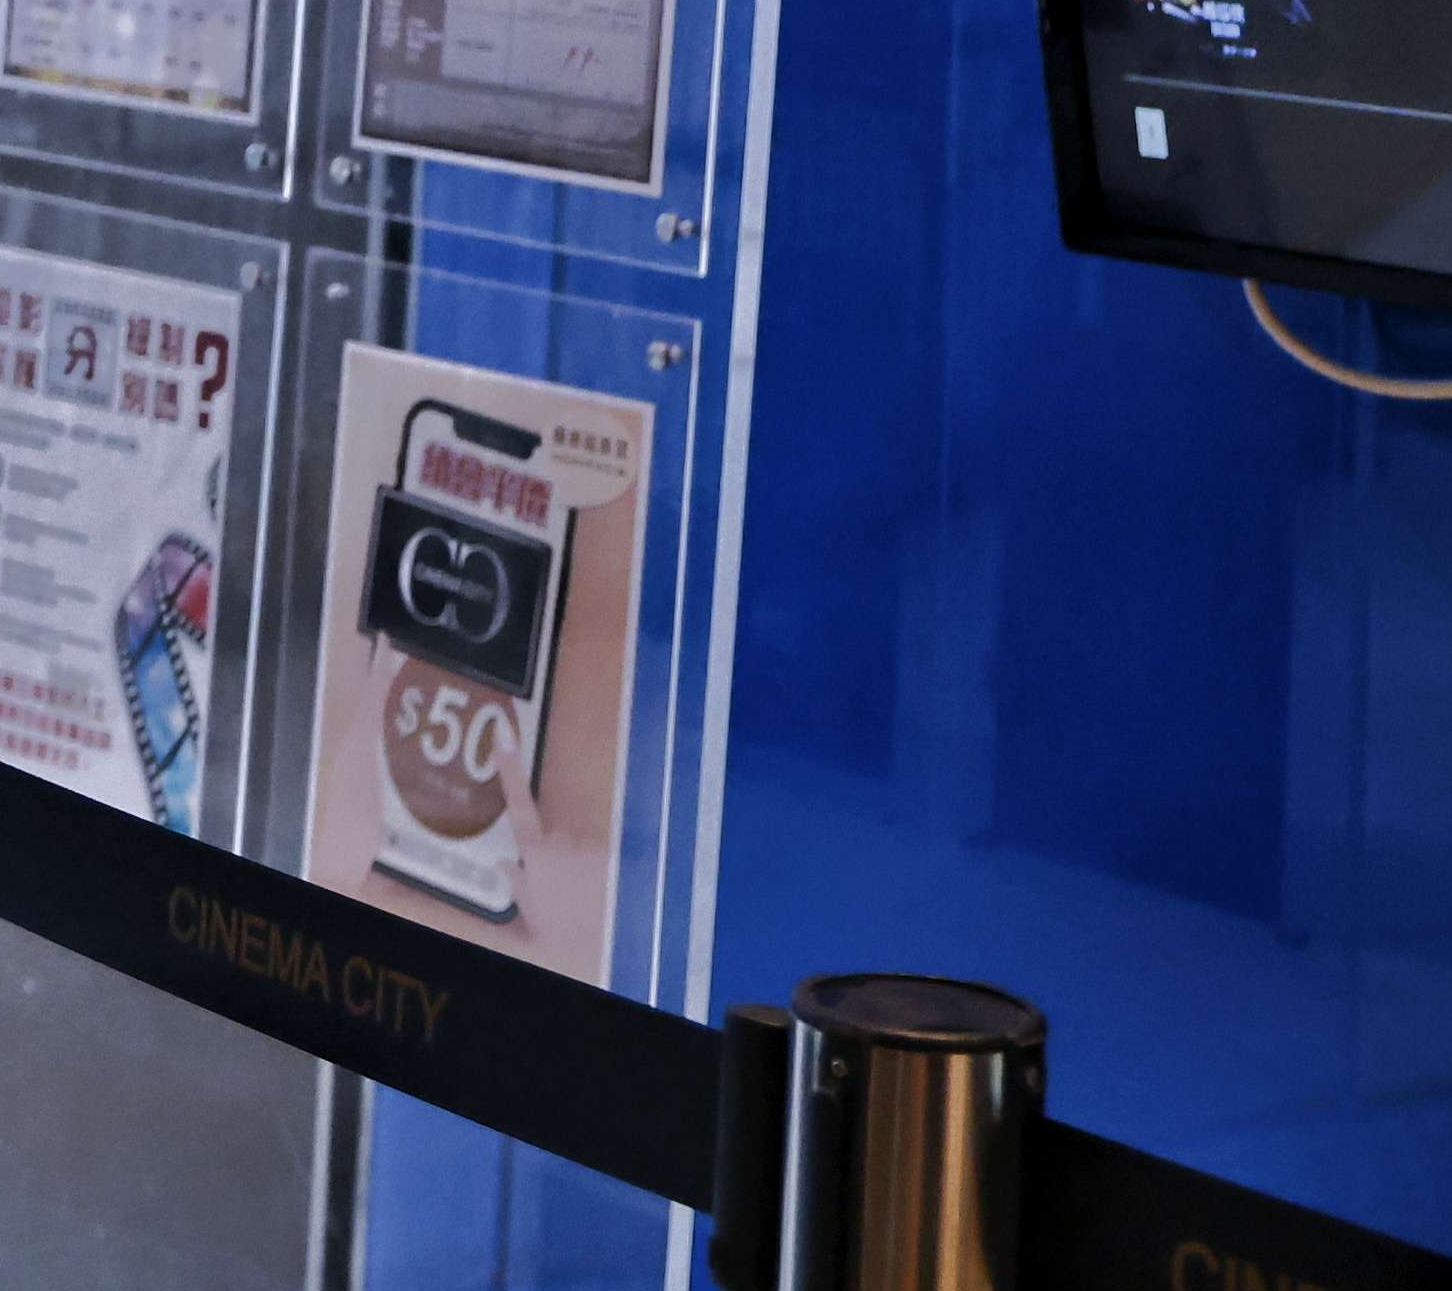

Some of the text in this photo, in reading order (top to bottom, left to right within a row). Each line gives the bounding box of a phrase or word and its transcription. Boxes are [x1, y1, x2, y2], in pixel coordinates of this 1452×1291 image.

[395, 684, 514, 784] $50
[167, 885, 455, 1046] CINEMA CITY
